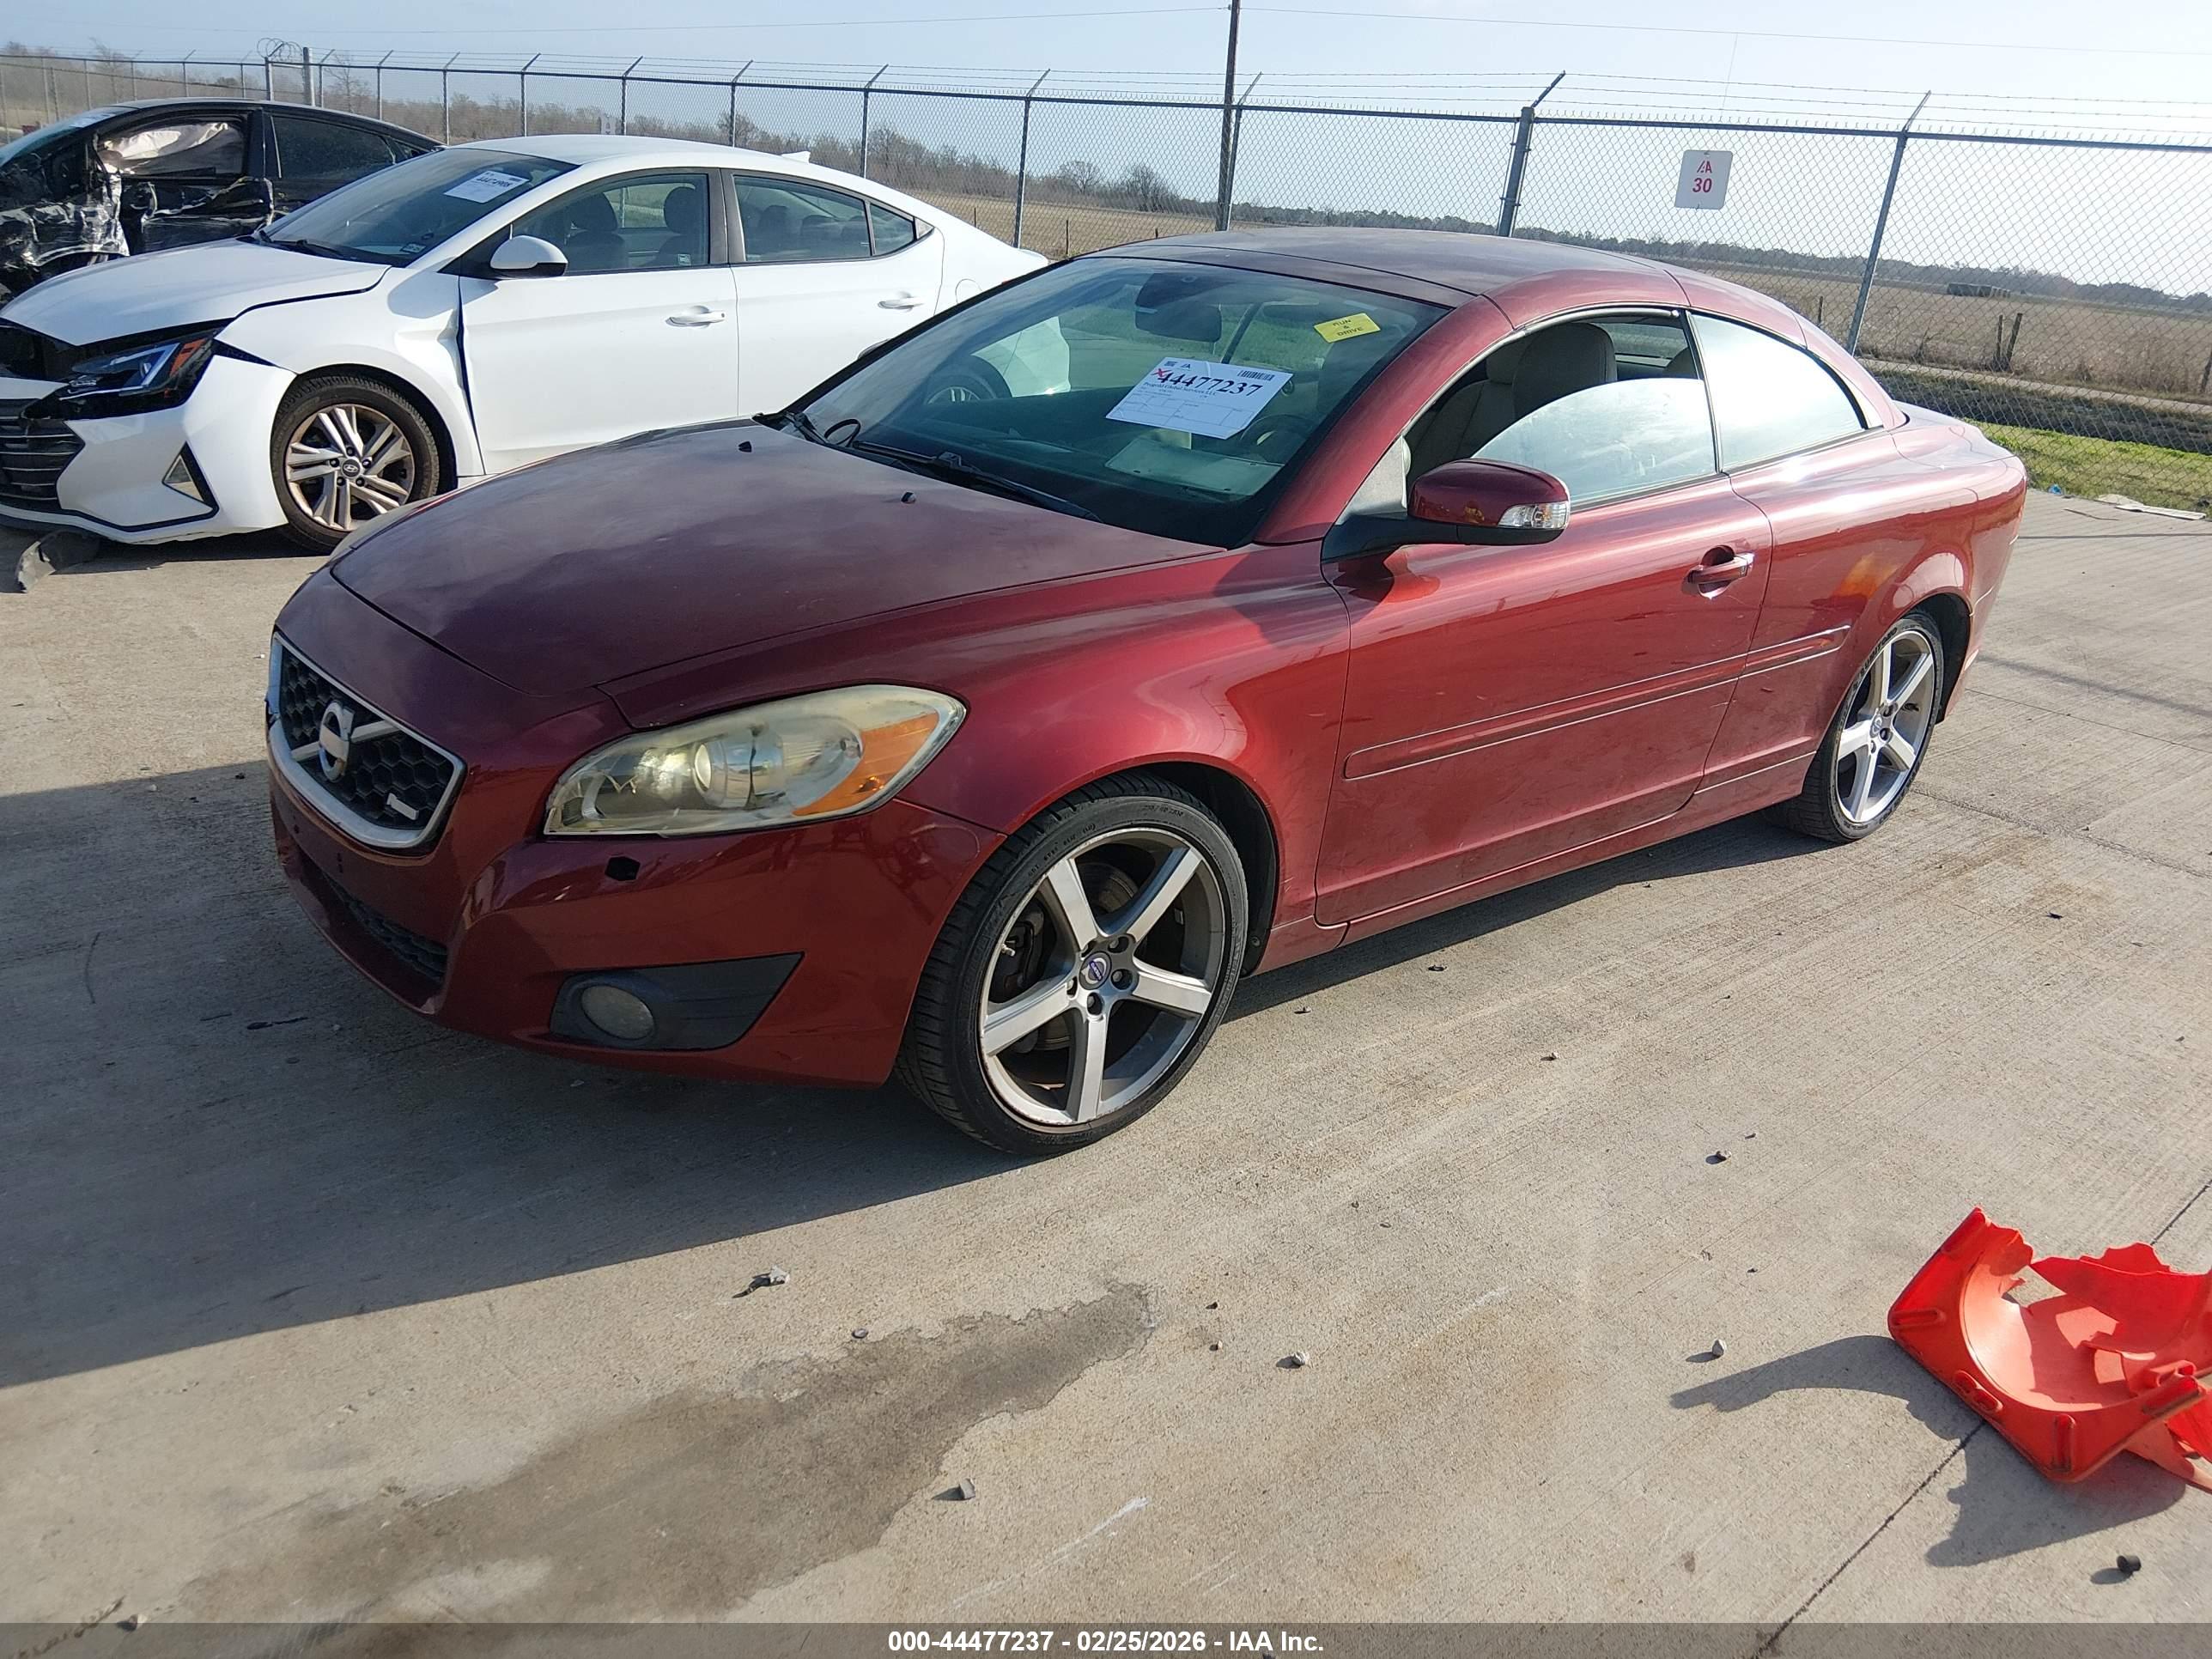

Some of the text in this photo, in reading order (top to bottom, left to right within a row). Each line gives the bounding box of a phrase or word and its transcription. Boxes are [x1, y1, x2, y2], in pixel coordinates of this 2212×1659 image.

[1692, 178, 1712, 192] 30
[1336, 327, 1364, 336] DRIVE
[1158, 373, 1263, 396] 44477237
